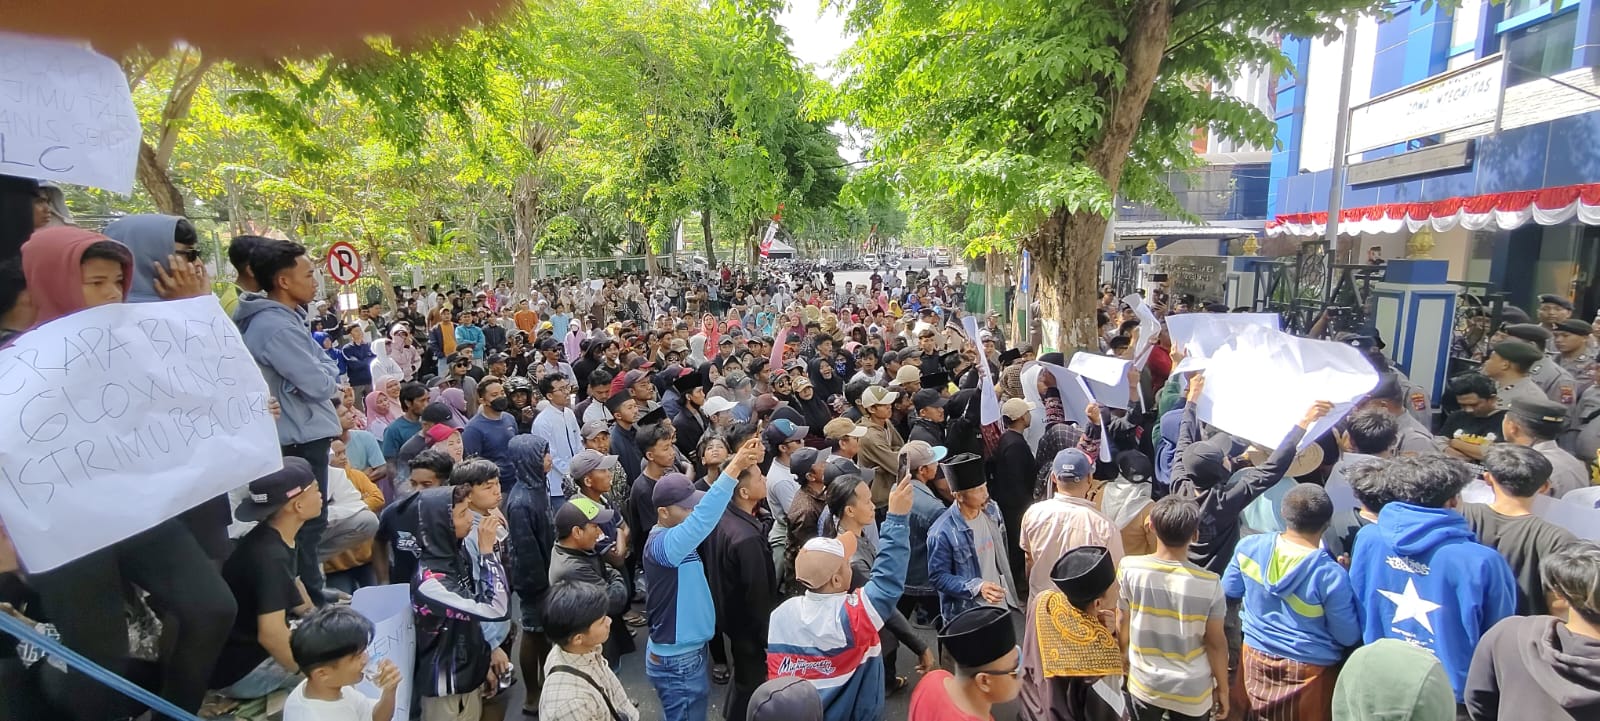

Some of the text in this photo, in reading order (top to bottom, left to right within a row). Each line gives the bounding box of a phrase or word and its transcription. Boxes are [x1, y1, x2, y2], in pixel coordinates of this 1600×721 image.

[137, 316, 239, 360] BIAYA
[19, 354, 238, 444] GLOWING
[1, 420, 171, 510] ISTRIMU
